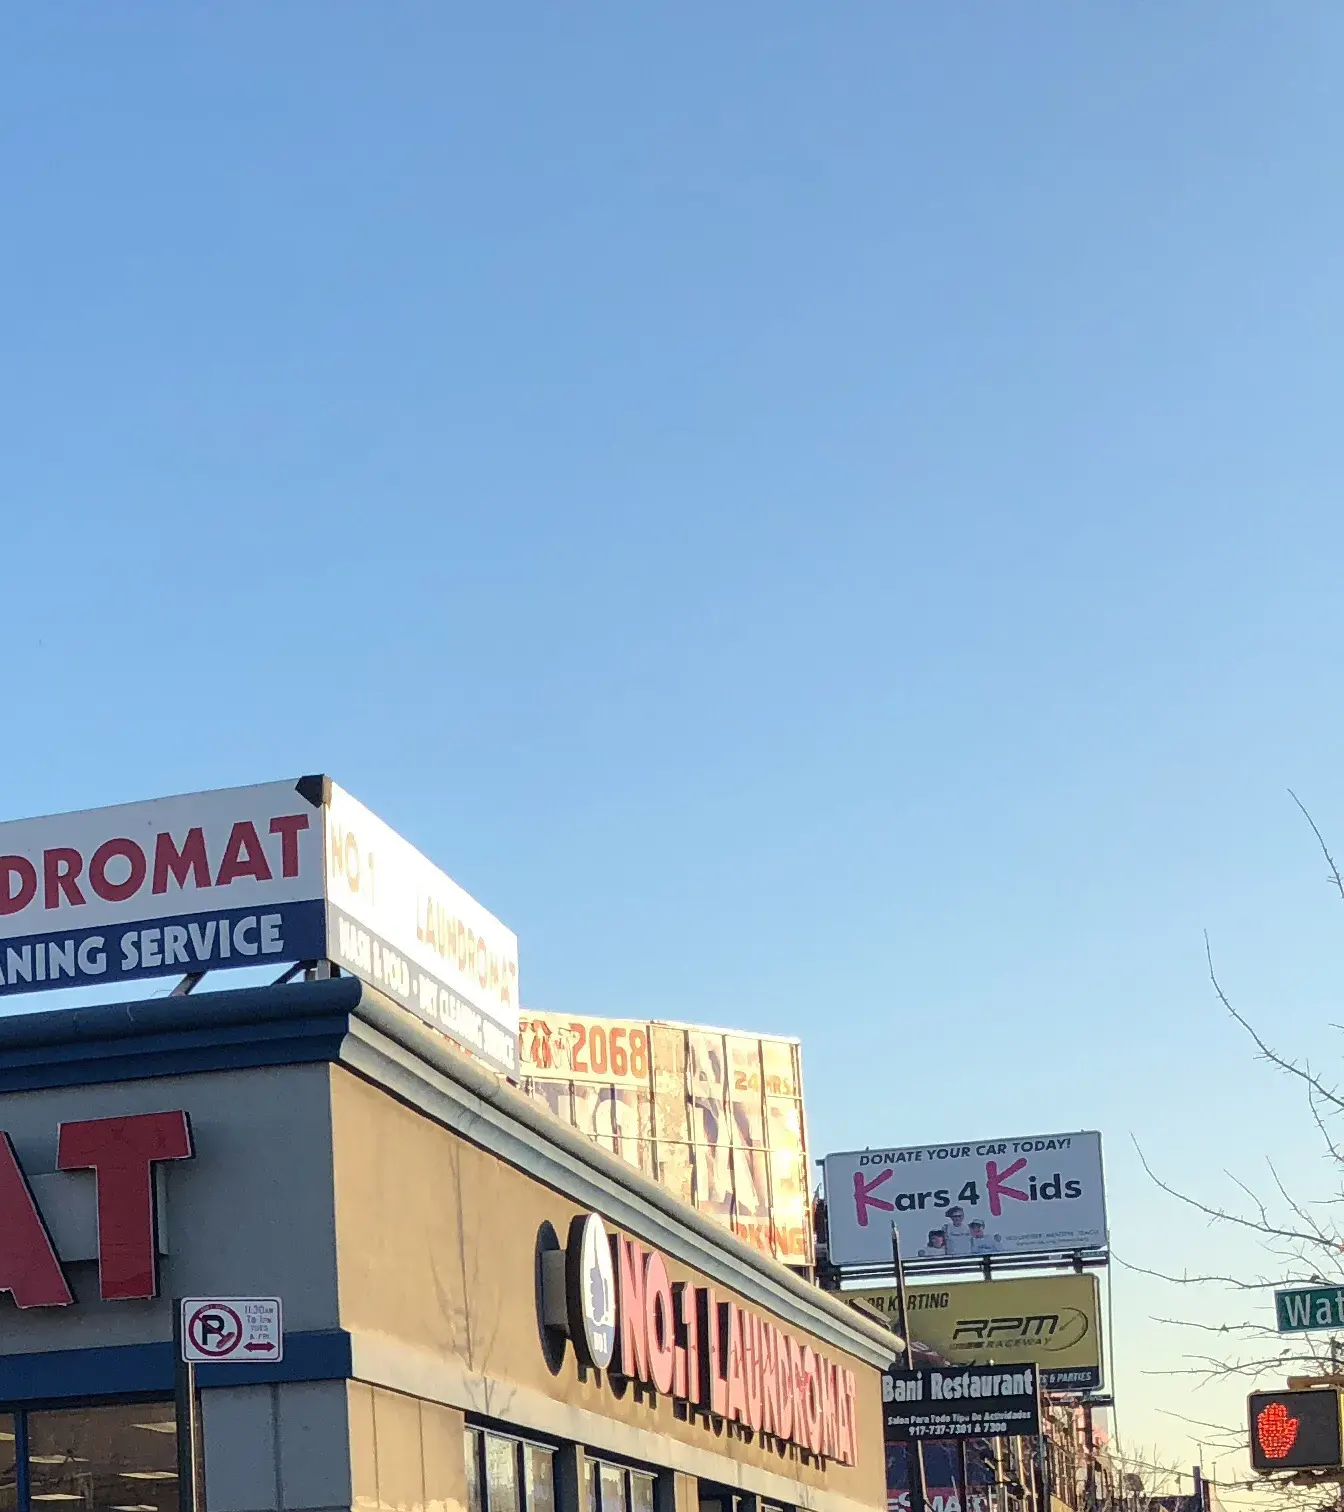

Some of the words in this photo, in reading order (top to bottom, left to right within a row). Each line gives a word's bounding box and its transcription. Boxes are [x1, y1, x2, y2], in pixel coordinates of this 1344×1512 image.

[120, 912, 285, 973] SERVICE
[859, 1150, 922, 1167] DONATE
[928, 1146, 970, 1161] YOUR
[976, 1143, 1007, 1157] CAR
[1012, 1137, 1072, 1153] TODAY!
[853, 1168, 951, 1227] Kars
[958, 1180, 980, 1206] 4
[985, 1157, 1083, 1217] Kids
[888, 1292, 949, 1311] KRTING
[953, 1314, 1060, 1341] RPM
[984, 1337, 1054, 1350] RACEWAY
[709, 1287, 858, 1468] LAUNDROMAT
[882, 1373, 923, 1403] Bani
[930, 1368, 1033, 1401] Restaurant
[1057, 1371, 1092, 1383] PARTIES
[888, 1416, 909, 1426] Salon
[911, 1415, 930, 1424] Para
[931, 1414, 951, 1423] Todo
